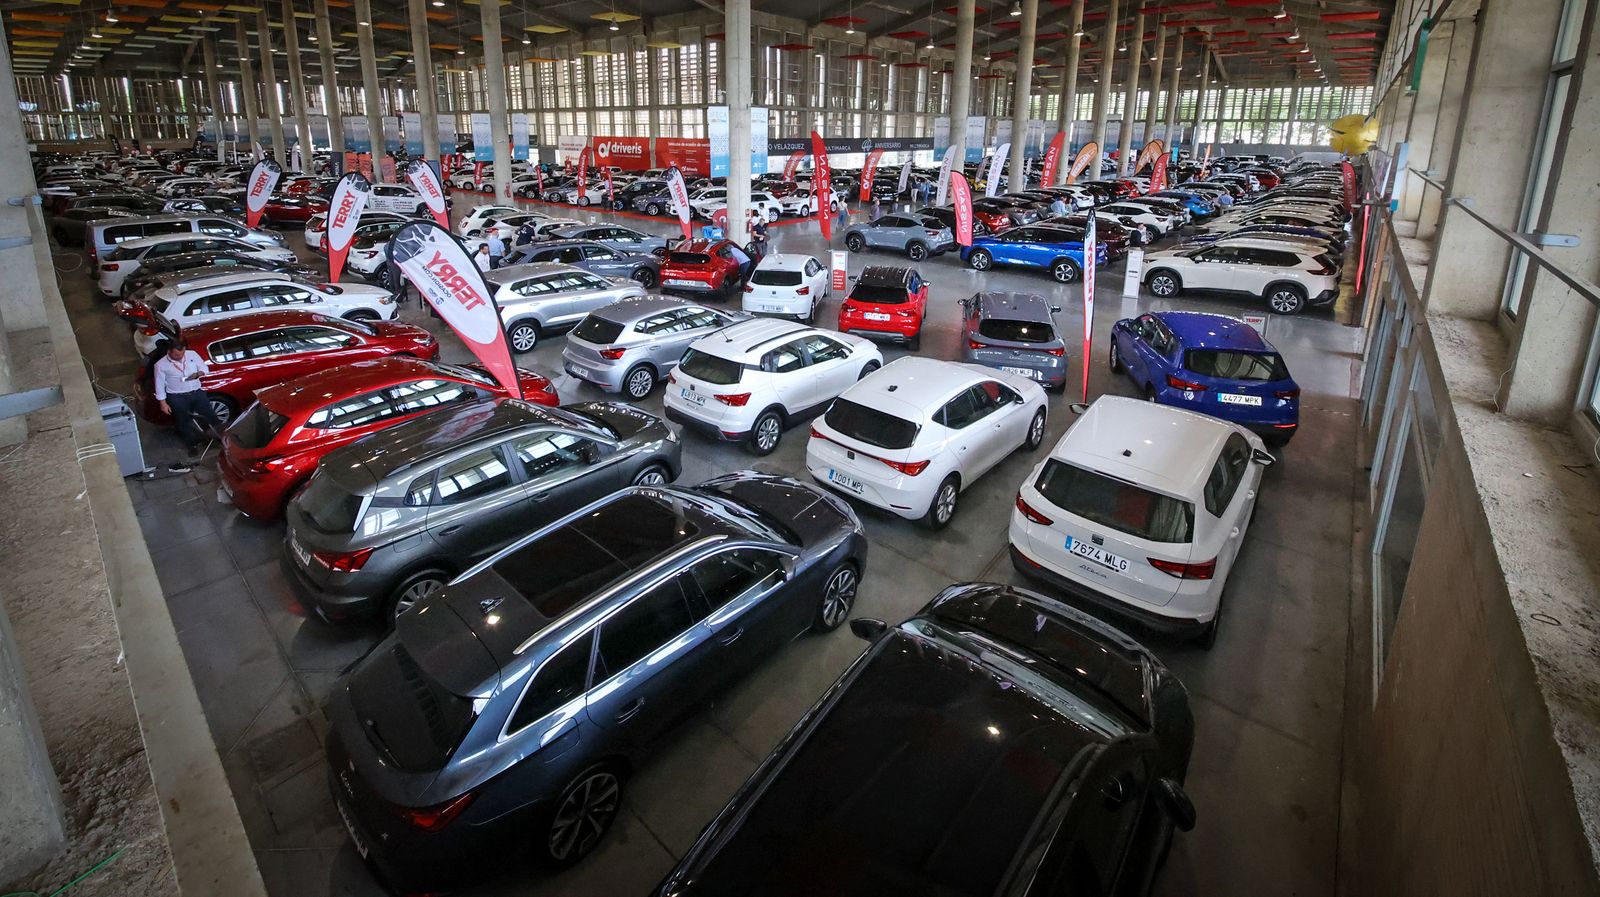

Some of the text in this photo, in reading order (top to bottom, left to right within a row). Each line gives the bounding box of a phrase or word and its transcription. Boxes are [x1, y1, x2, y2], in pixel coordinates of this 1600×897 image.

[611, 141, 642, 154] driveris
[1041, 146, 1056, 189] NISSAN
[250, 171, 270, 198] TERRY
[332, 190, 356, 229] TERRY
[1223, 395, 1243, 403] 4477
[834, 472, 864, 492] 1001 MPL
[1073, 540, 1127, 570] 7674 MLG
